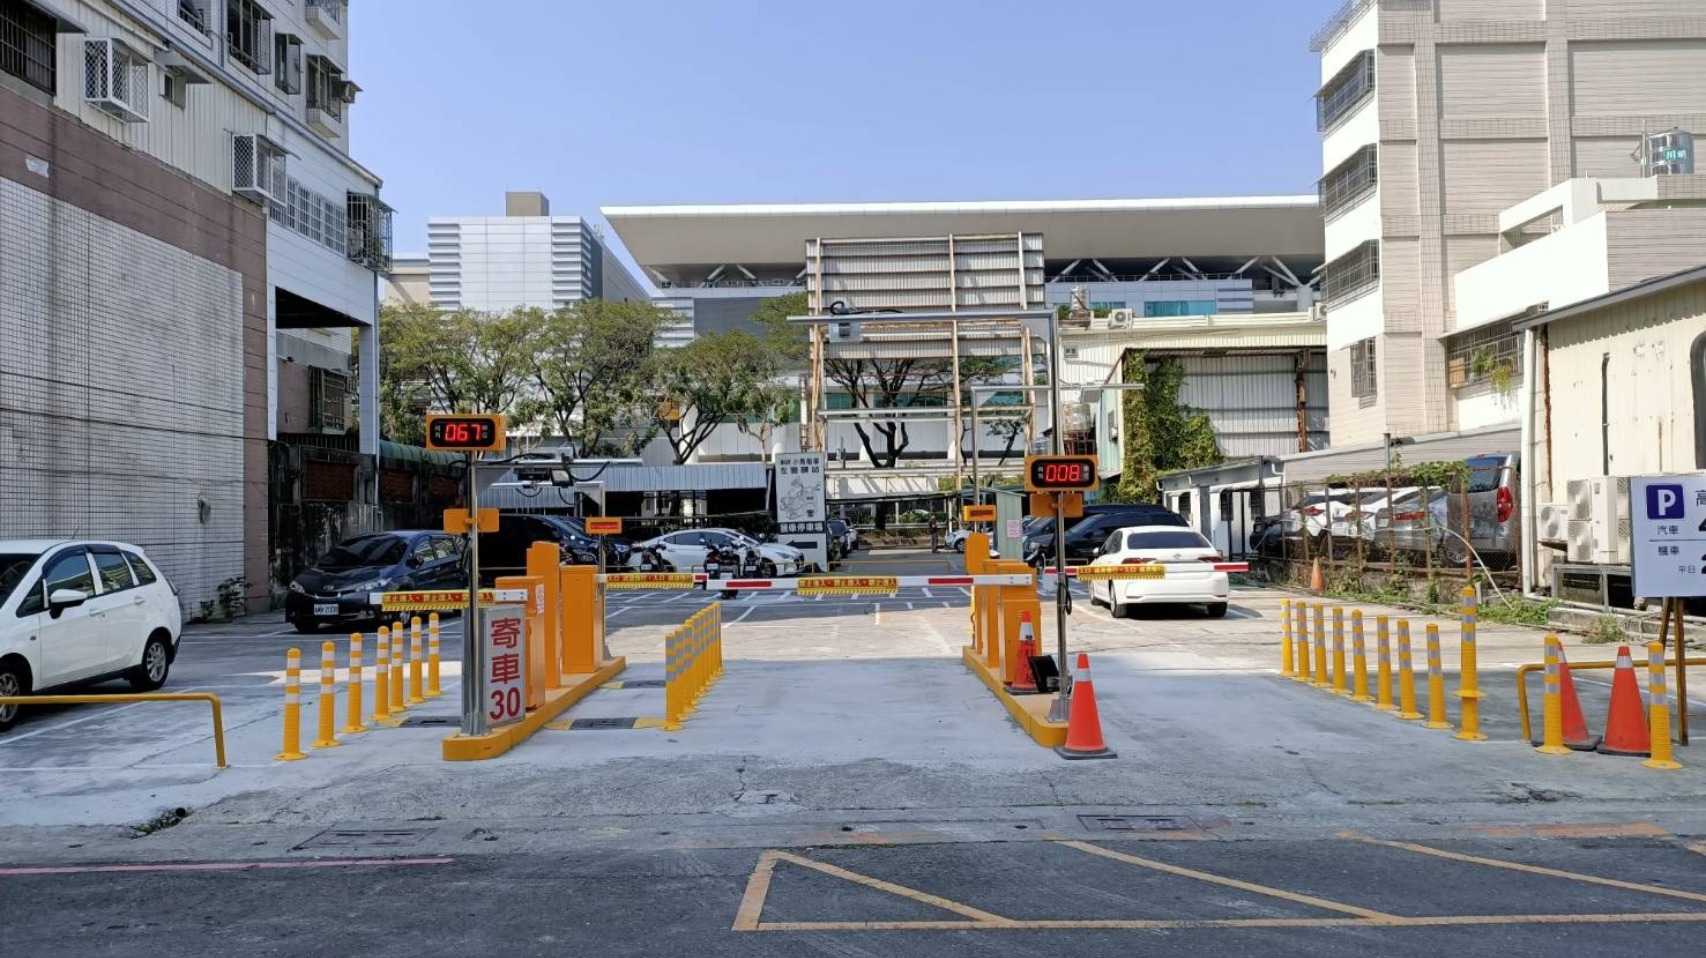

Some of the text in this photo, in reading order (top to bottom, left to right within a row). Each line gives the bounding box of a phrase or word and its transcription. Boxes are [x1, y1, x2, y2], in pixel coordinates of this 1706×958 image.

[445, 424, 481, 441] 067
[1046, 464, 1080, 481] 008
[1657, 489, 1677, 516] P
[1657, 525, 1679, 535] 汽車
[1658, 545, 1679, 556] 機車
[1678, 564, 1695, 574] 平日
[489, 617, 521, 720] 寄車 30
